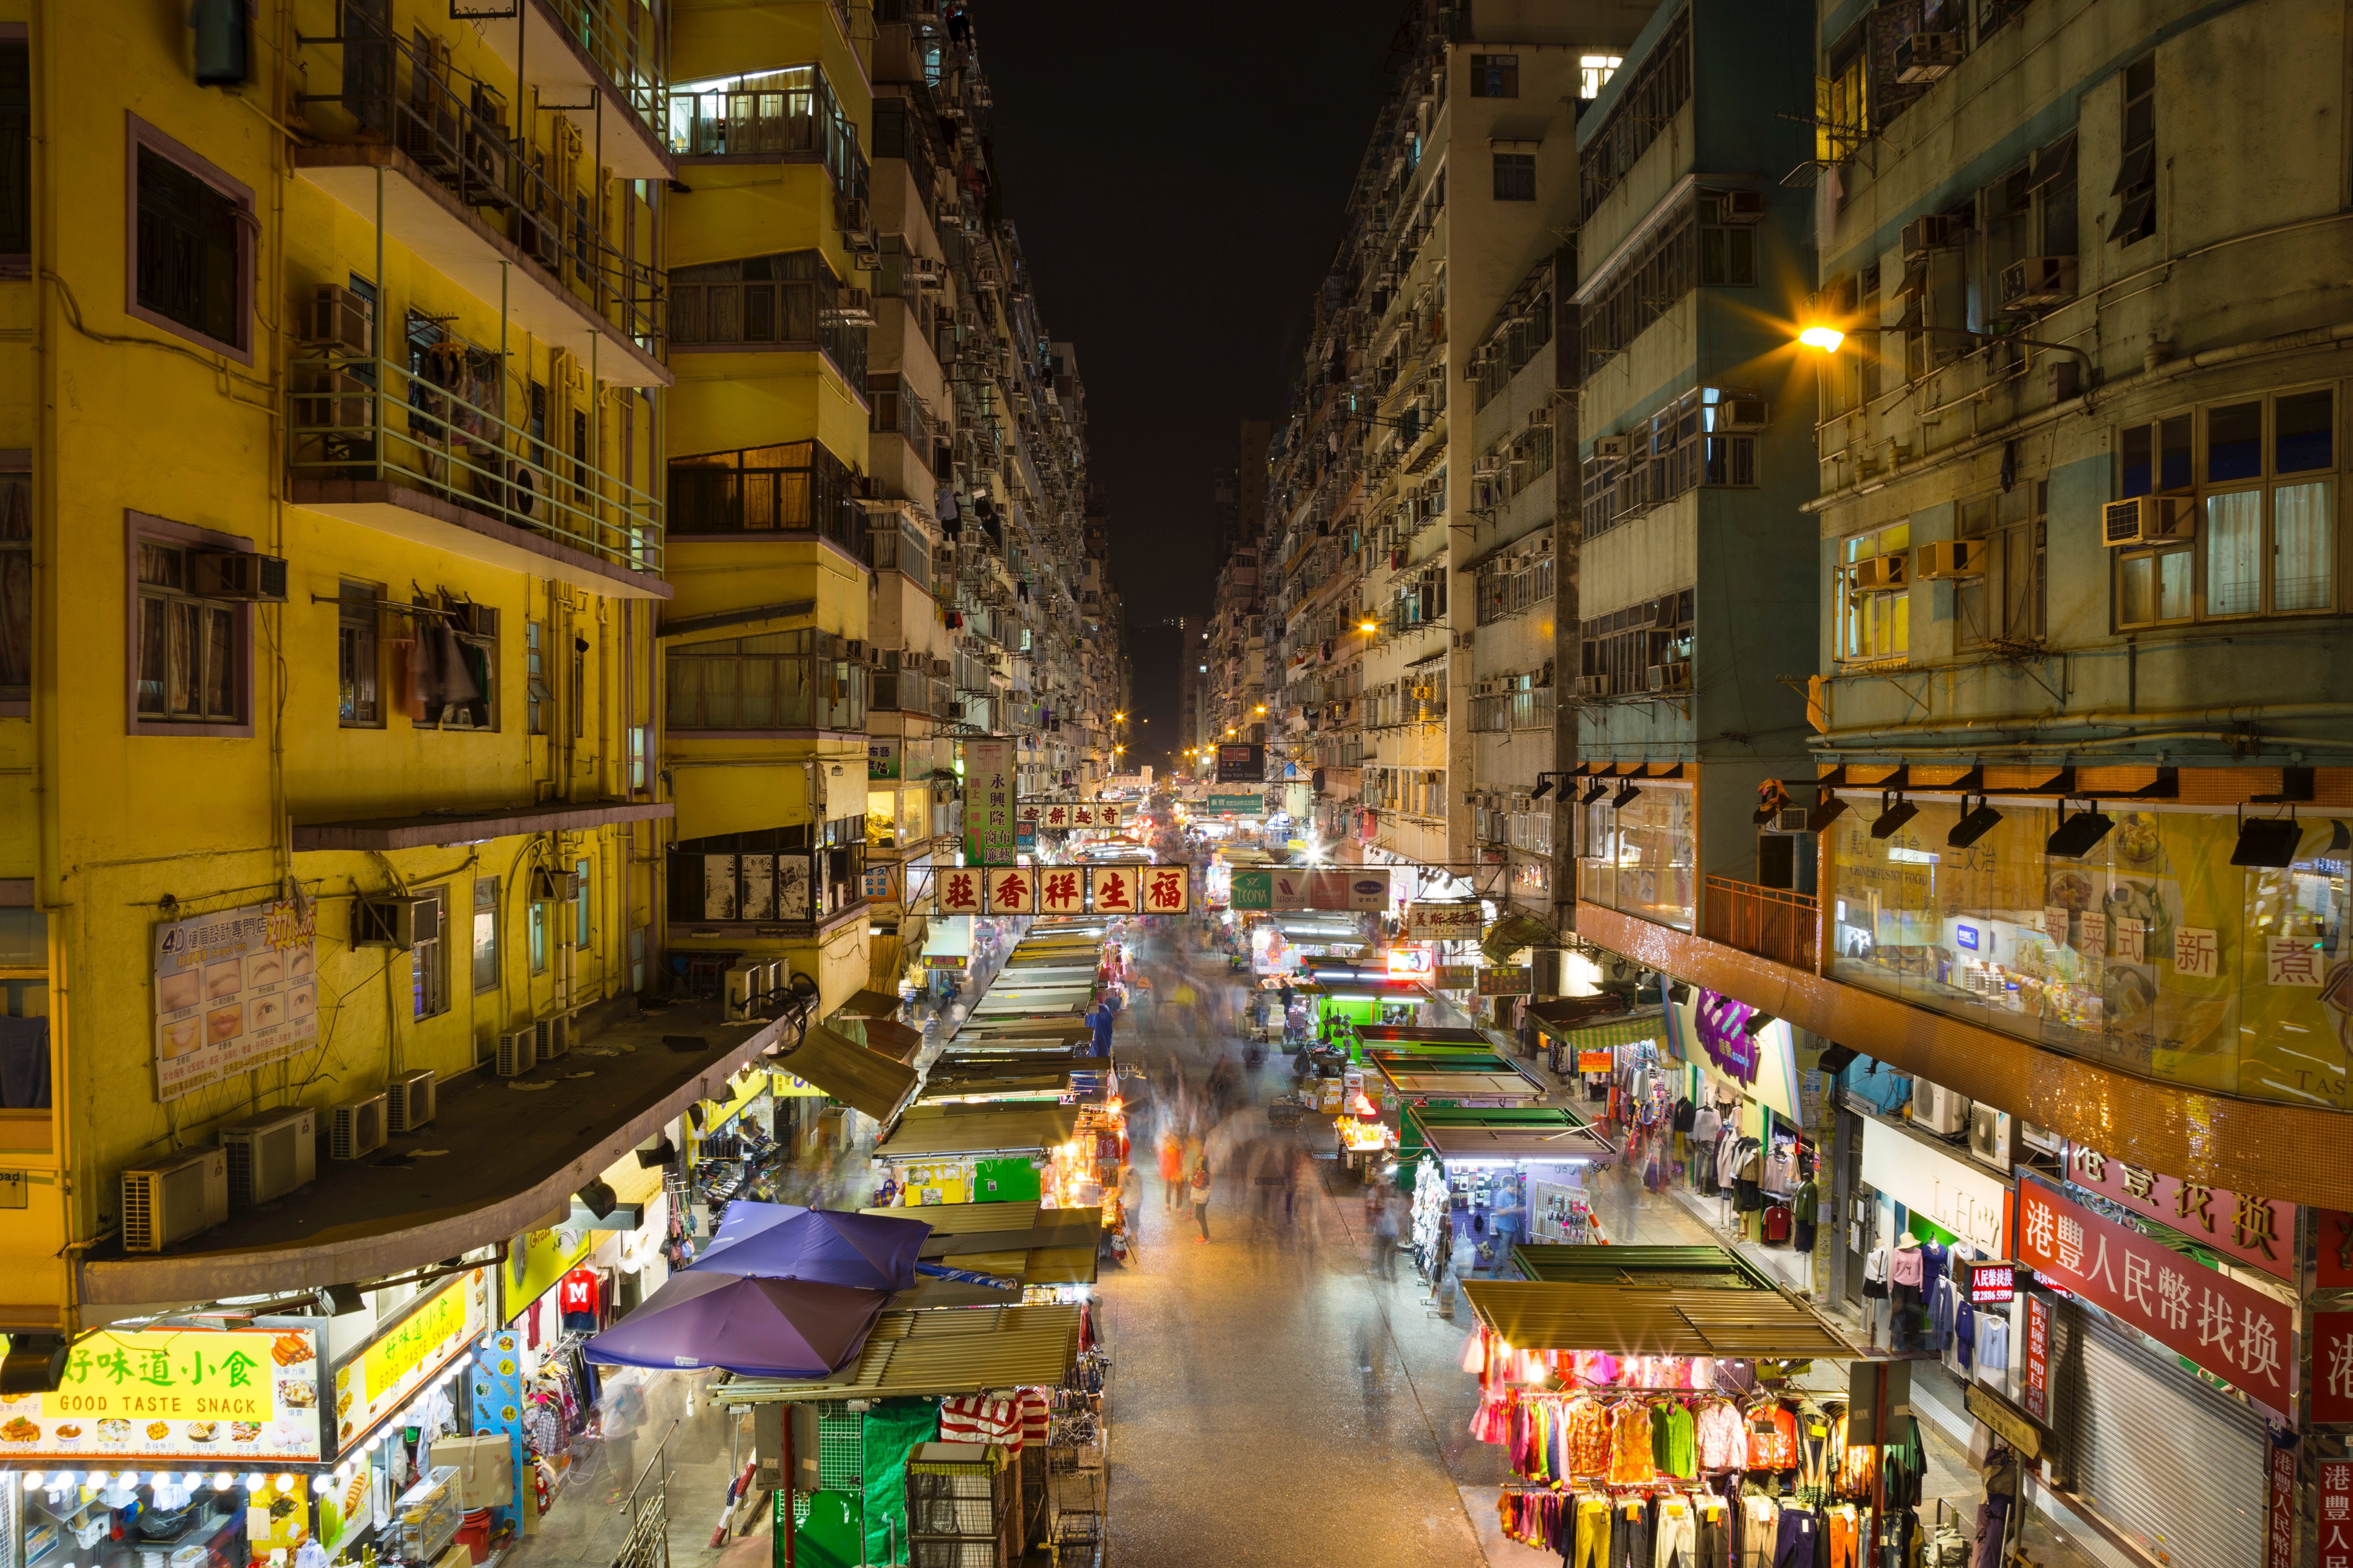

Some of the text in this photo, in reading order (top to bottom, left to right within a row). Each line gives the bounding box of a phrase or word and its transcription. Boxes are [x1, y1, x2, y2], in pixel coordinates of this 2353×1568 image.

[970, 778, 981, 822] 請上一樓
[989, 774, 1005, 826] 永興隆
[1905, 872, 1927, 885] FOOD
[1238, 889, 1266, 903] LEONA
[1317, 888, 1341, 897] Triumph
[162, 926, 186, 955] 4D
[271, 914, 292, 941] 2771
[211, 944, 233, 959] Angel
[235, 941, 247, 952] Ho
[2177, 929, 2216, 976] 新
[2271, 938, 2322, 983] 煮
[2295, 1069, 2353, 1096] TAS
[568, 1283, 588, 1303] M
[1979, 1290, 2012, 1301] 2886 5599
[385, 1298, 448, 1360] 好味道小食
[64, 1347, 258, 1388] 好味道小食
[380, 1319, 454, 1389] GOOD TASTE SNACK
[60, 1395, 255, 1414] GOOD TASTE SNACK
[1983, 1396, 2019, 1429] Fa Yuen Street
[1990, 1415, 2011, 1439] 花園街
